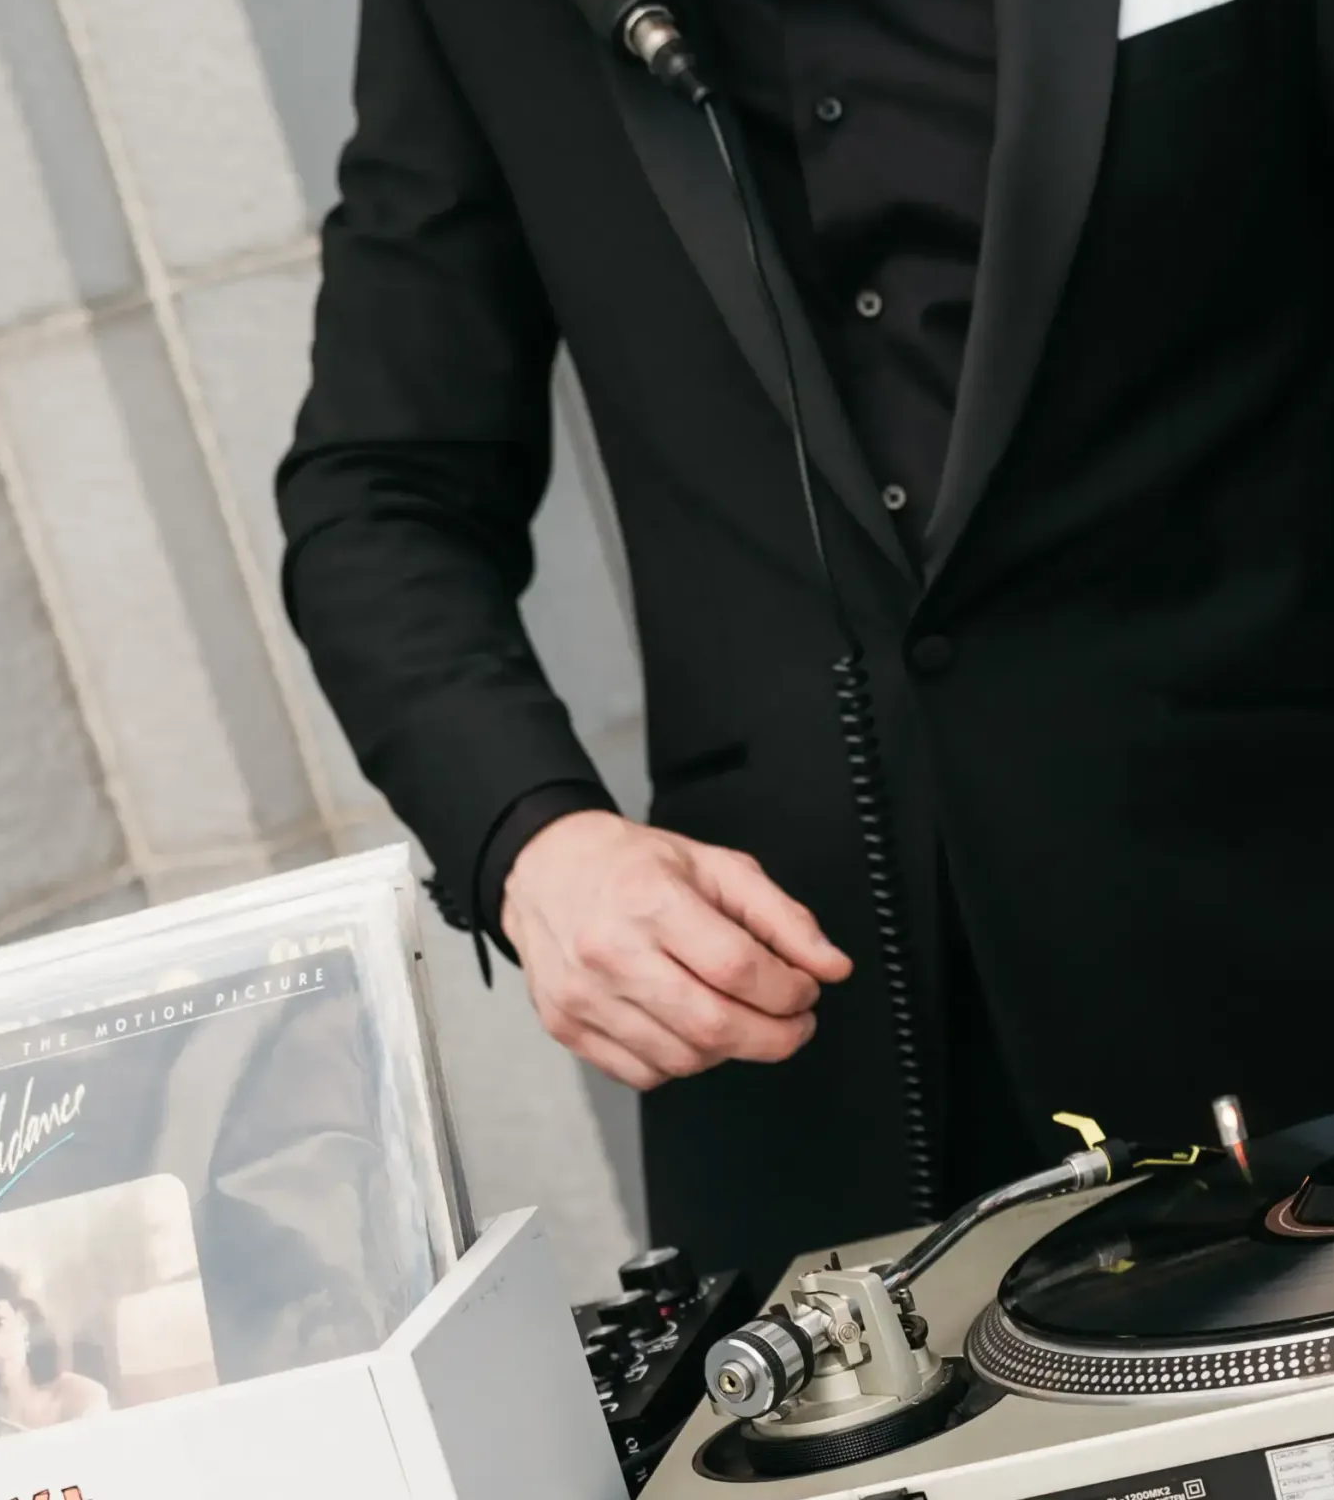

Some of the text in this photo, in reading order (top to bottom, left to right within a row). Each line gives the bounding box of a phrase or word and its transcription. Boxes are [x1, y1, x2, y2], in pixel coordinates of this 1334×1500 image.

[22, 1032, 69, 1057] THE
[94, 1000, 195, 1039] MOTION
[216, 967, 325, 1006] PICTURE
